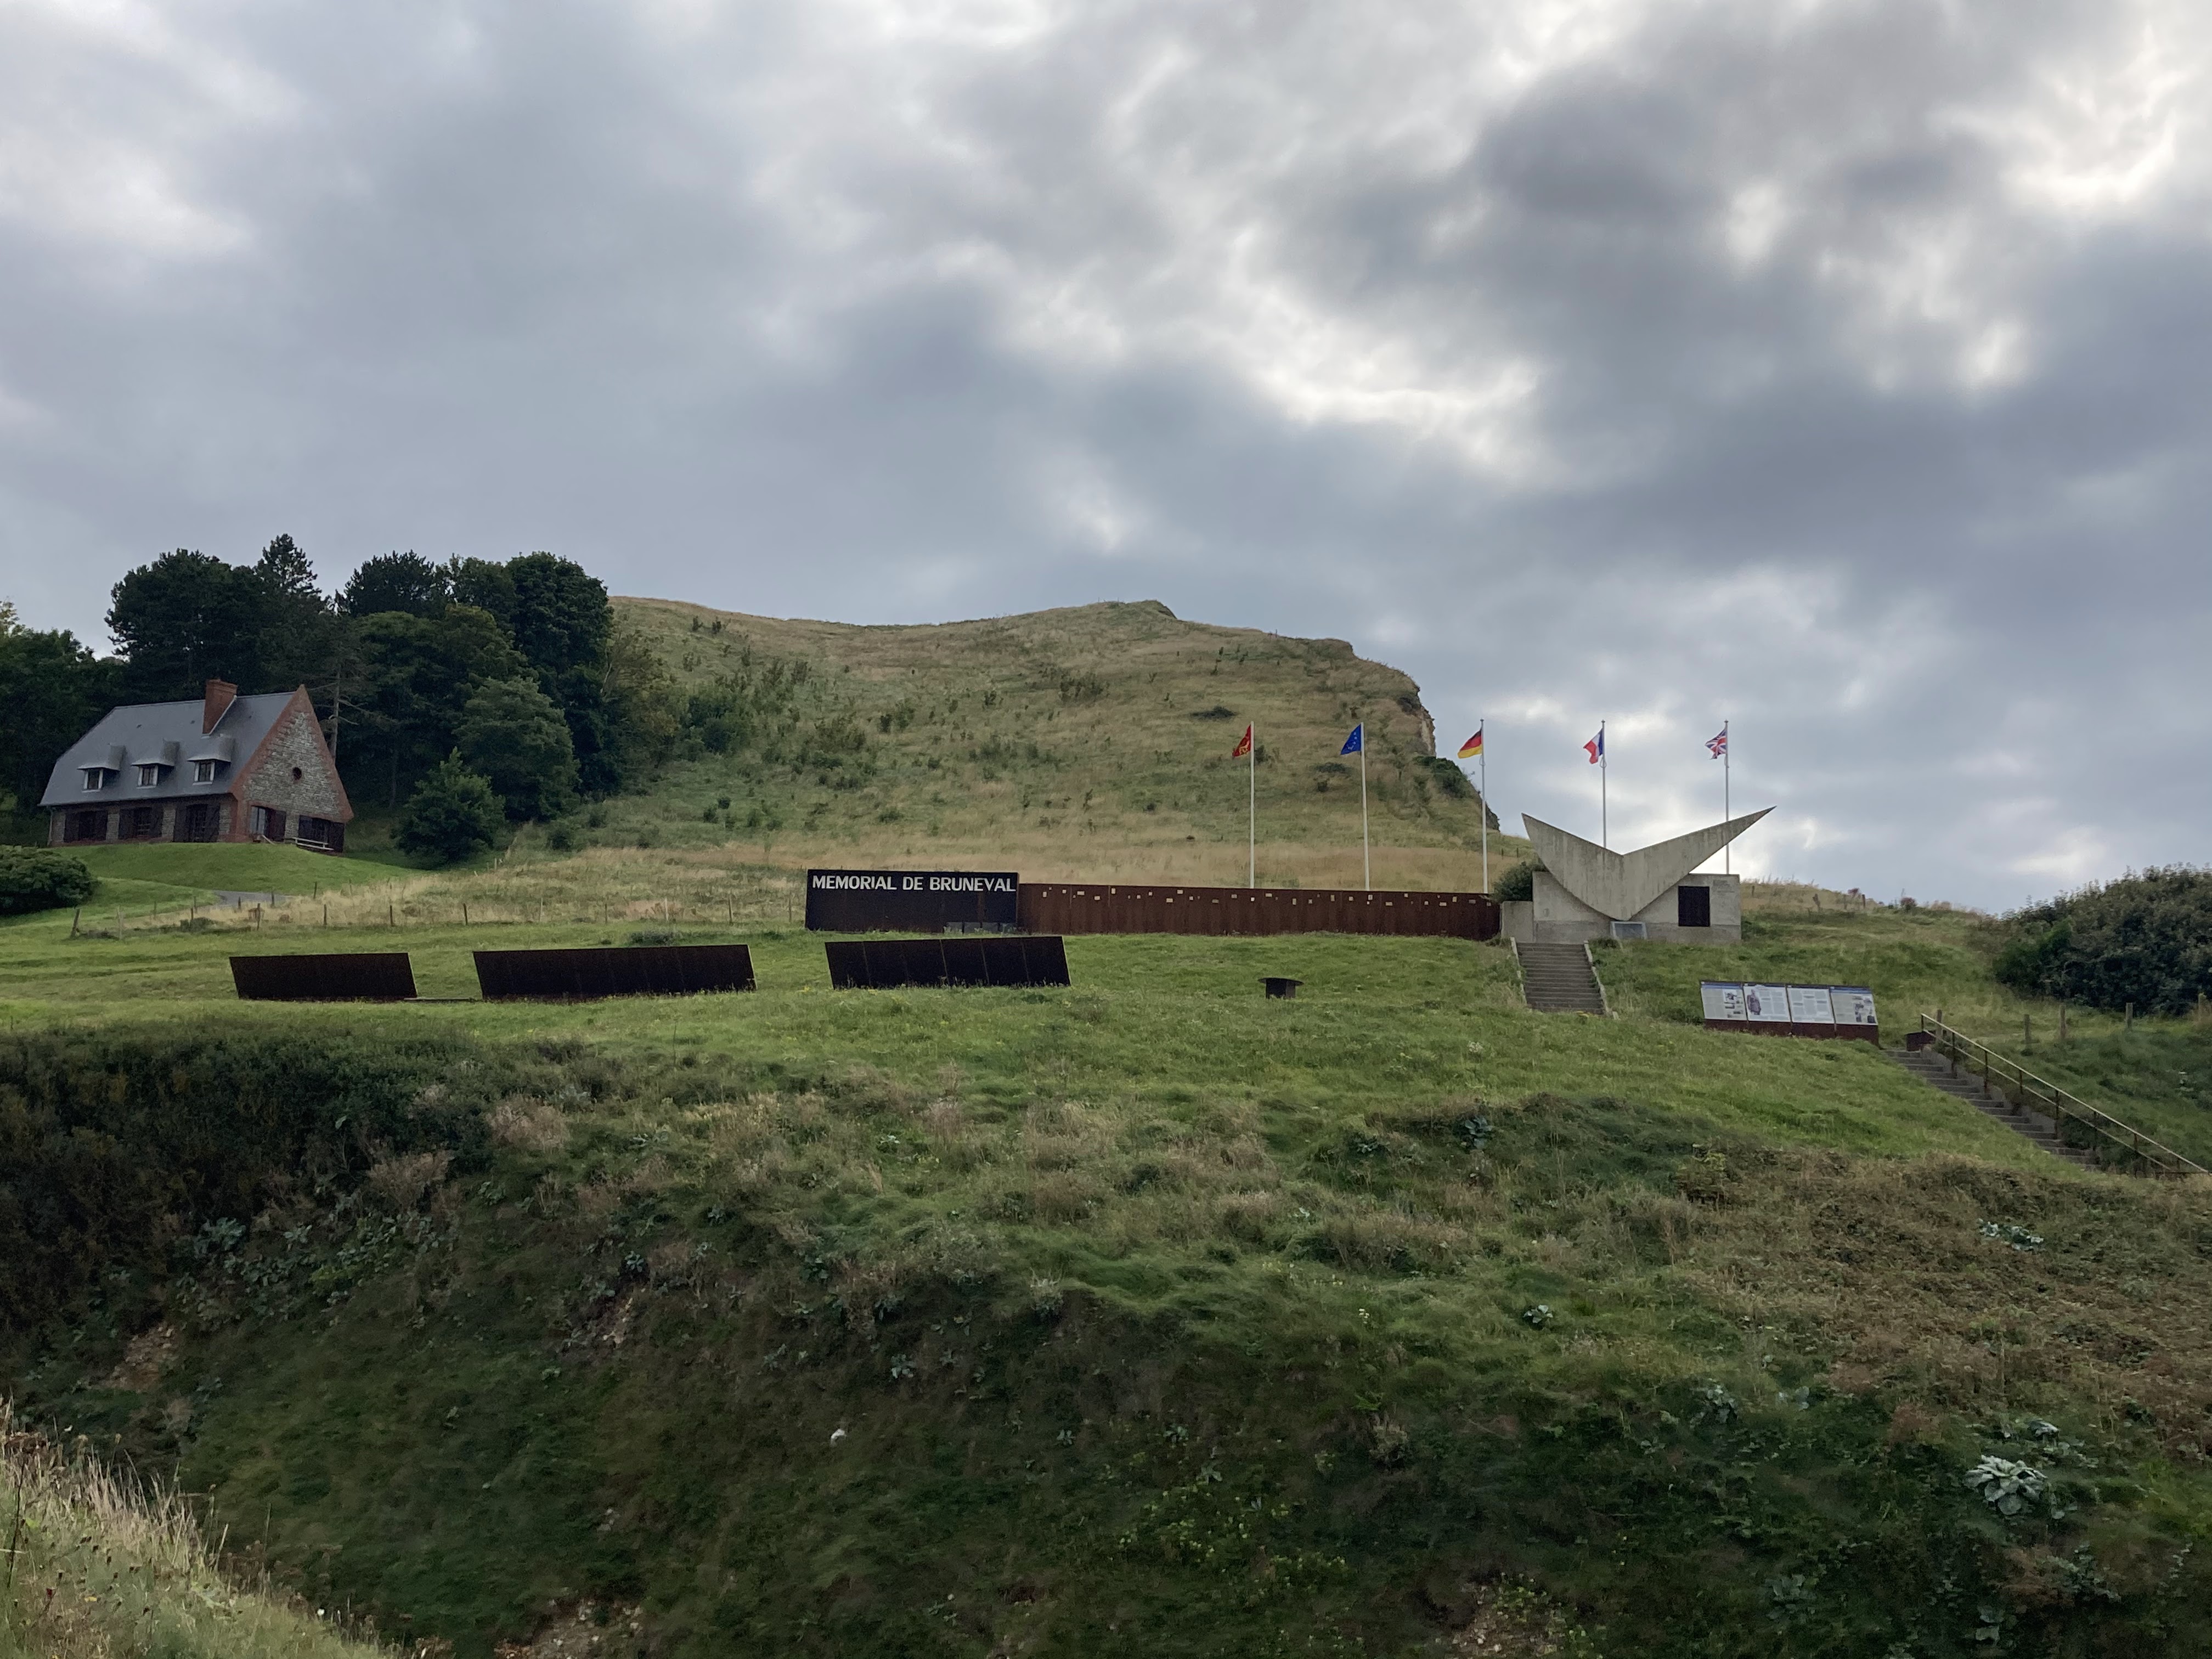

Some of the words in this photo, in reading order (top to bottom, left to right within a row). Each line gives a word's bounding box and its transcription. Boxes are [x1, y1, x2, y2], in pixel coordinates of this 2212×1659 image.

[812, 875, 897, 890] MEMORIAL
[902, 877, 924, 890] DE
[929, 877, 1016, 891] BRUNEVAL
